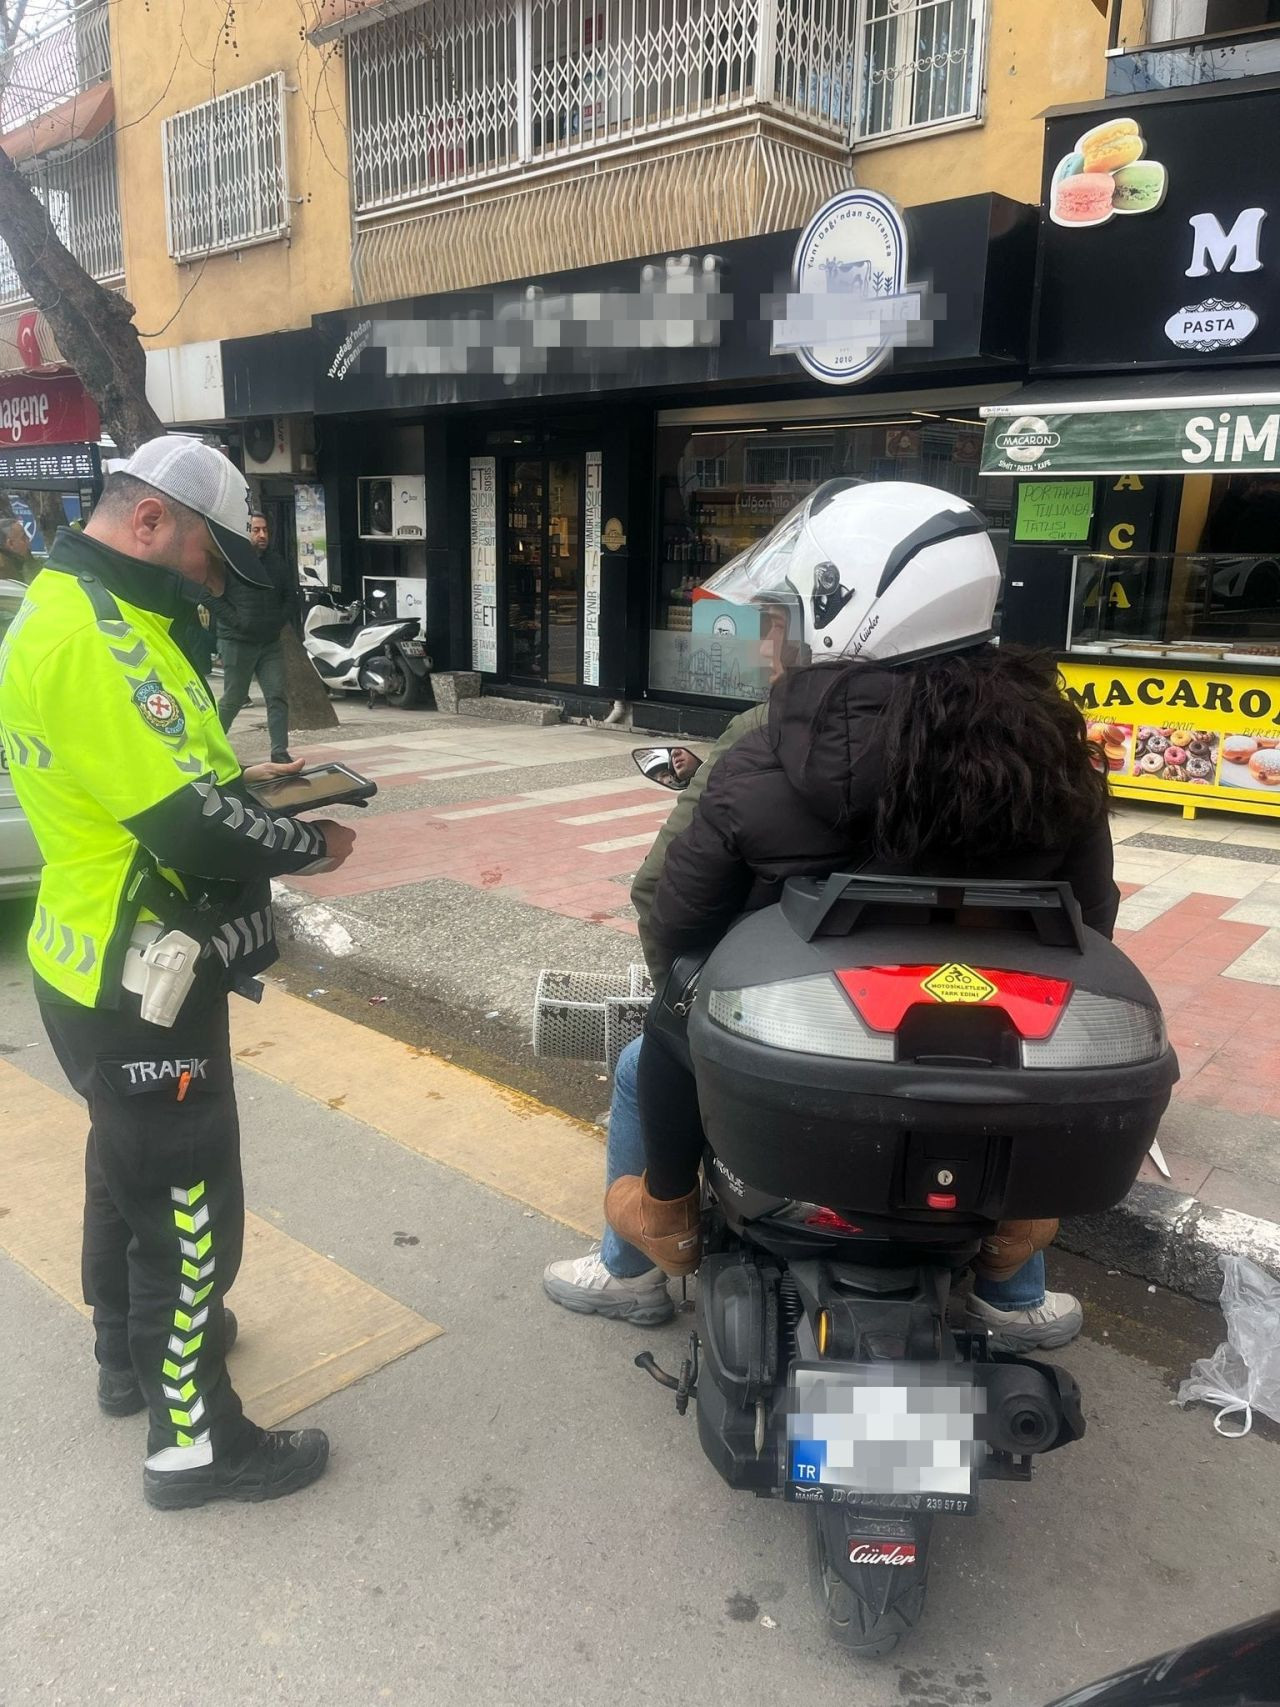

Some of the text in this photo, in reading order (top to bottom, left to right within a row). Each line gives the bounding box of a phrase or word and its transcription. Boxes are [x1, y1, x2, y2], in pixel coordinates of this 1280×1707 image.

[1184, 207, 1268, 278] M
[807, 243, 820, 269] Yunt
[1183, 318, 1235, 334] PASTA
[834, 355, 853, 364] 2010
[0, 393, 49, 441] agene
[1003, 435, 1052, 445] MACARON
[586, 463, 602, 488] ET
[585, 506, 594, 549] YUMURTA
[483, 605, 497, 627] ET
[586, 590, 598, 631] PEYNİR
[1065, 678, 1280, 725] MACARO
[1162, 720, 1195, 731] DONUT
[798, 1464, 816, 1480] TR
